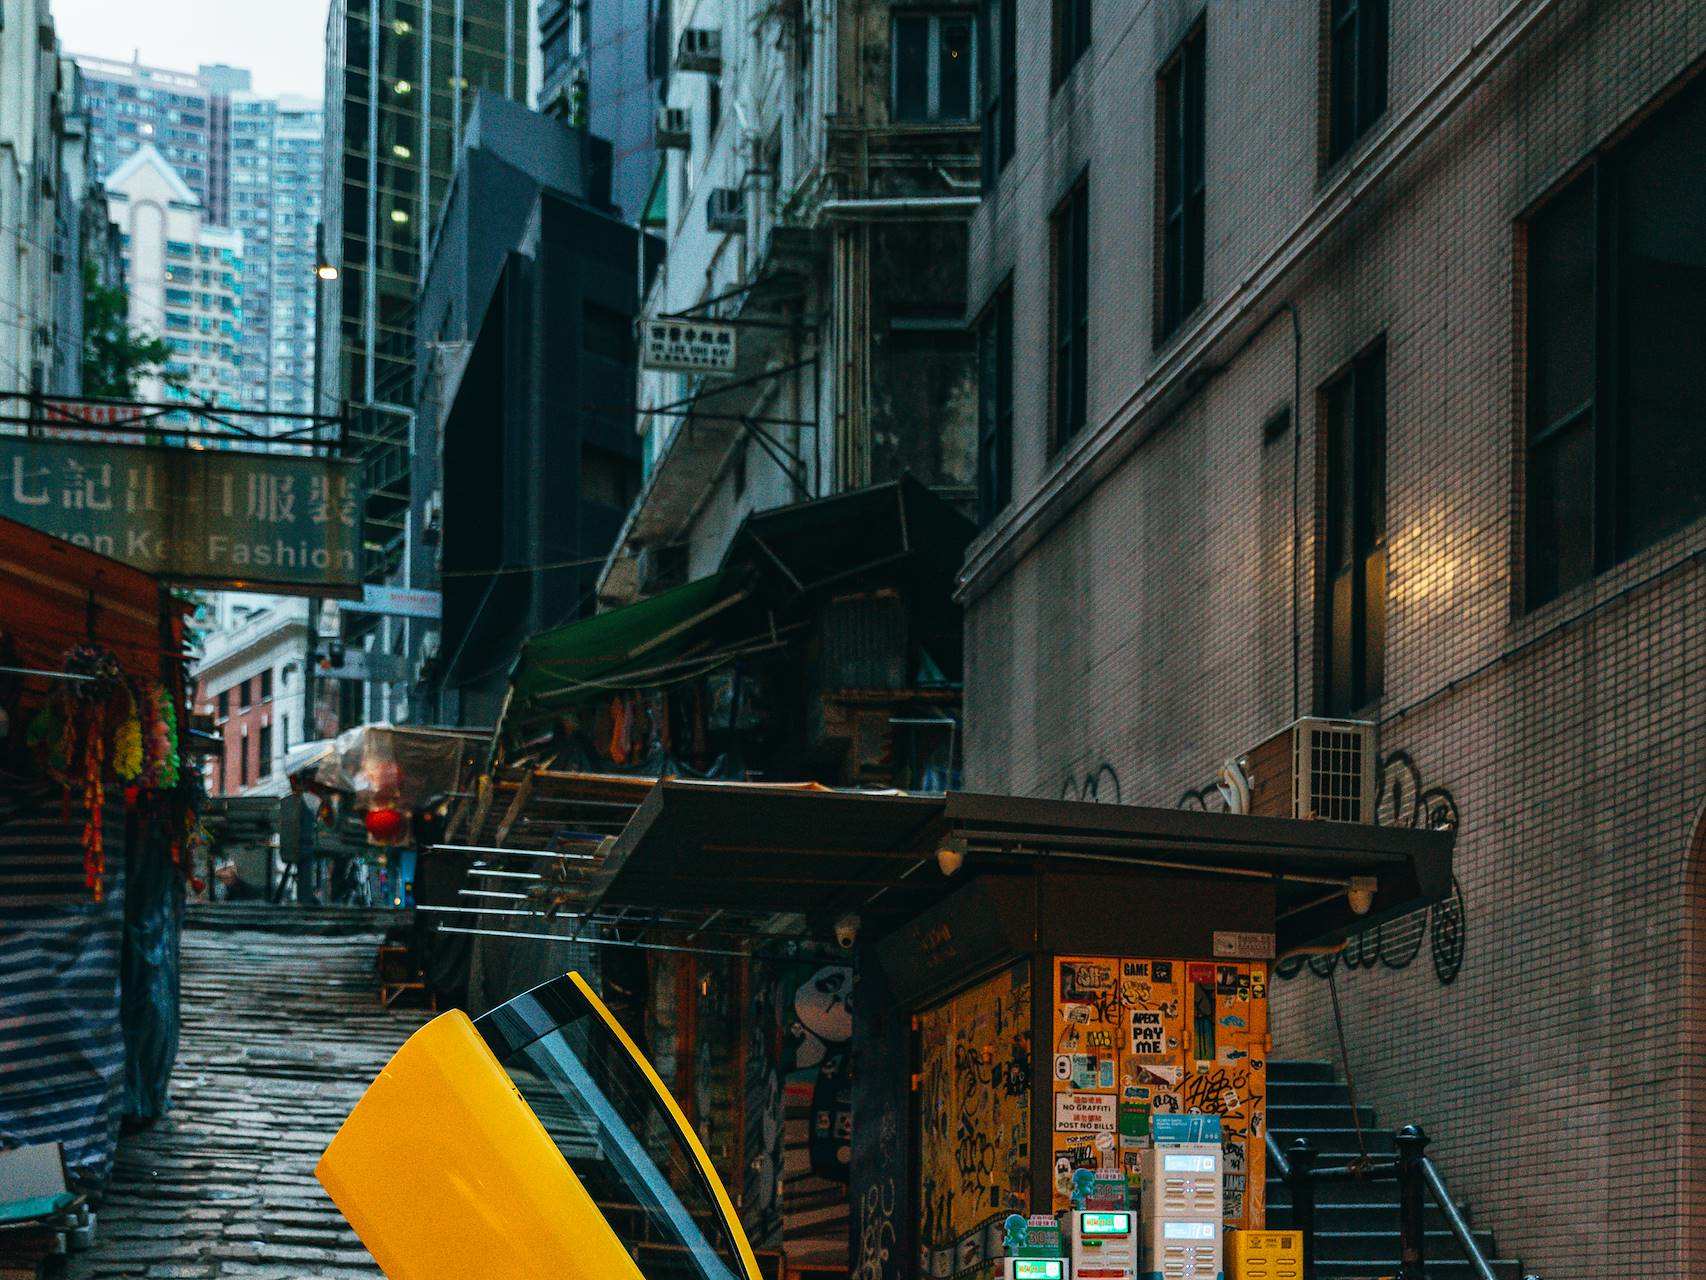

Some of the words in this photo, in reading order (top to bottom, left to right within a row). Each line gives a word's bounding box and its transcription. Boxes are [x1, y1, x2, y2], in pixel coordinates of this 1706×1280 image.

[208, 535, 356, 571] Fashion
[1123, 963, 1149, 976] GAME
[1133, 1027, 1163, 1040] PAY
[1136, 1041, 1162, 1054] ME
[1076, 1104, 1111, 1112] GRAFFITI
